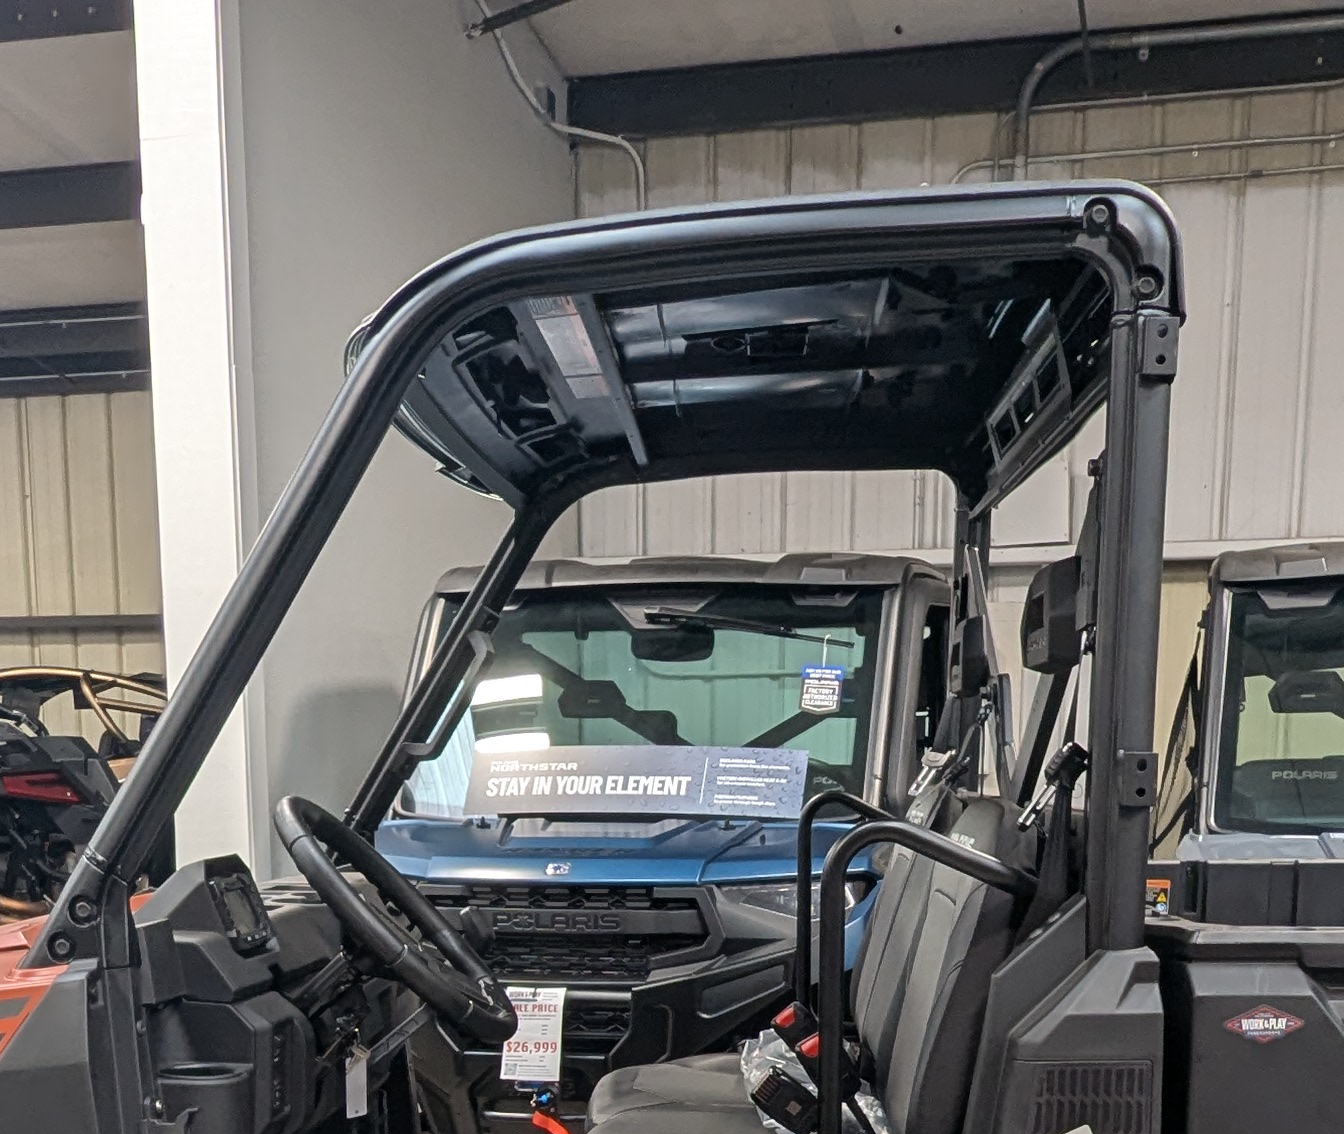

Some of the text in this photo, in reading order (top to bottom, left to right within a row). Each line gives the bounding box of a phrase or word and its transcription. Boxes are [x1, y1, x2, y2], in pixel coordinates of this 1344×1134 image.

[486, 775, 692, 797] STAY IN YOUR ELEMENT
[493, 912, 622, 932] POLARIS
[513, 1003, 558, 1013] ALE PRICE
[506, 1041, 558, 1054] $26,999
